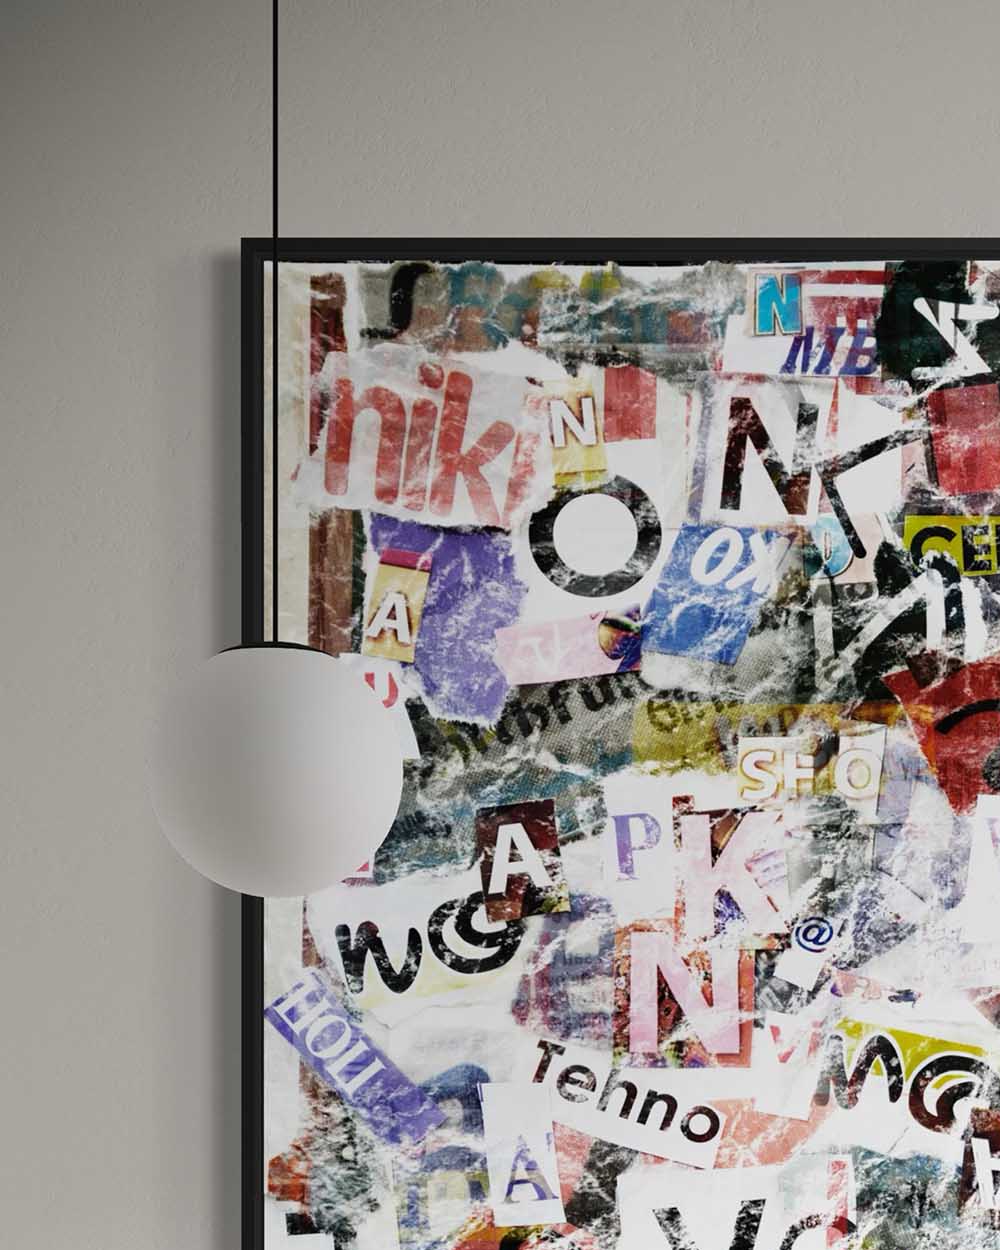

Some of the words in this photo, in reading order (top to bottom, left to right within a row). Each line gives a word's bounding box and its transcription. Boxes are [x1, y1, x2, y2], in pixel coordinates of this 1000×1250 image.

[548, 395, 597, 448] N
[364, 592, 413, 645] A
[487, 821, 553, 894] A
[611, 812, 662, 881] P
[628, 931, 740, 1054] N
[532, 1039, 721, 1143] Tehno
